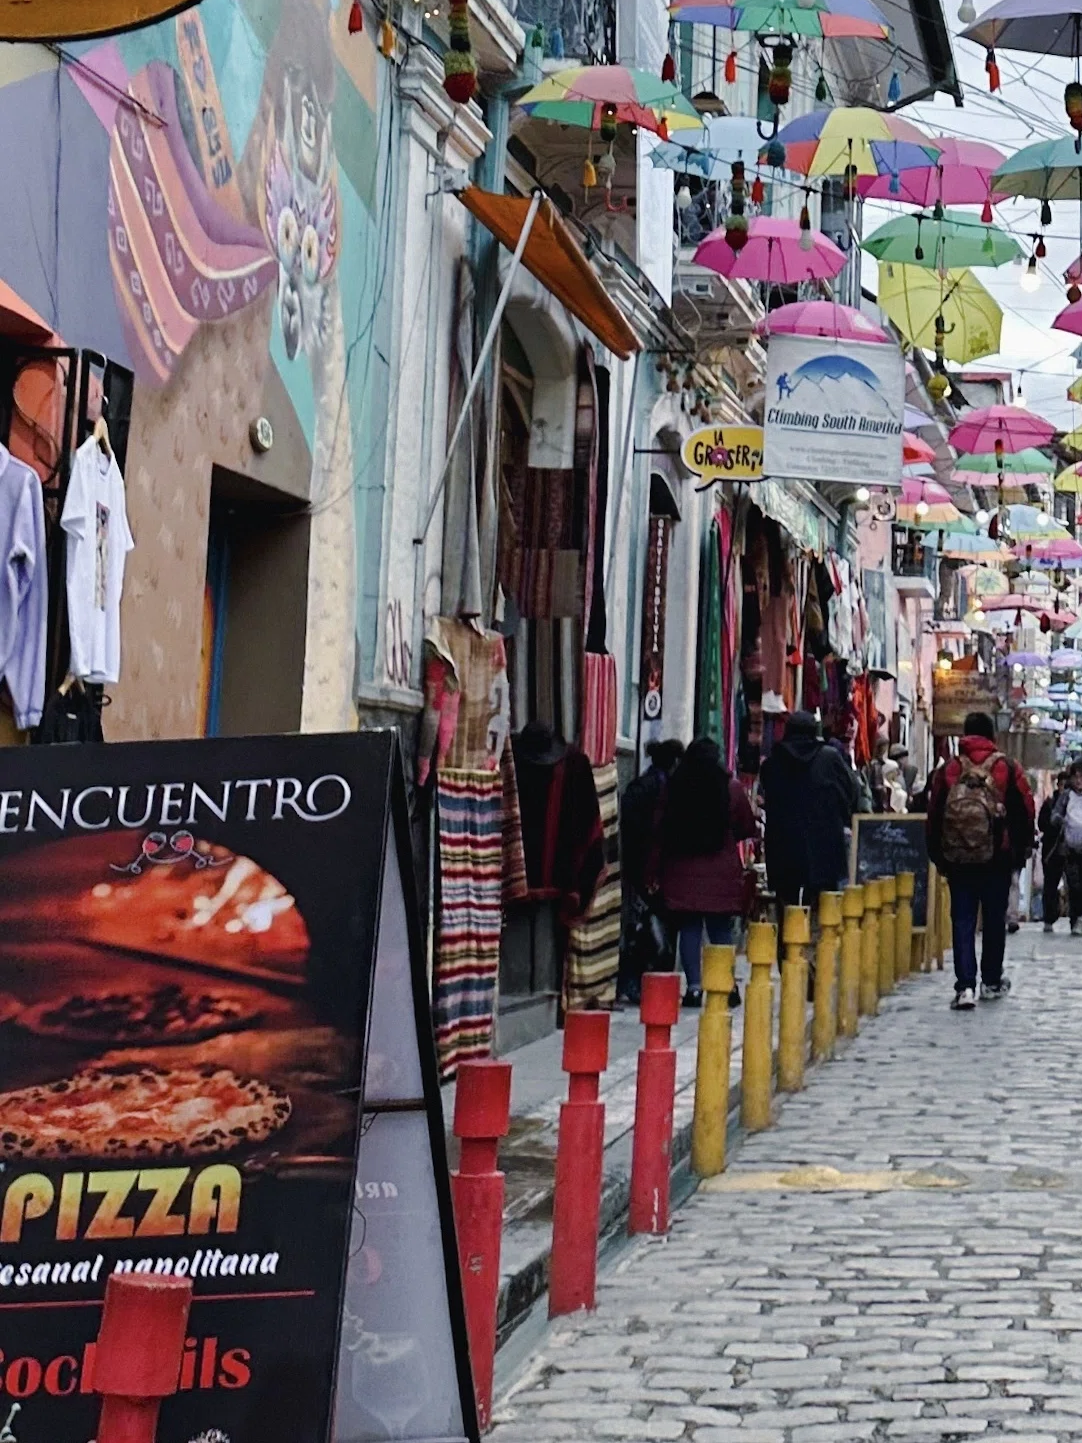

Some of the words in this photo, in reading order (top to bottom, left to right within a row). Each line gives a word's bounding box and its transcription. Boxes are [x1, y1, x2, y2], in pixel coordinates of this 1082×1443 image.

[714, 430, 724, 446] LA
[767, 407, 819, 430] Climbing
[821, 413, 857, 432] South
[652, 586, 661, 653] BOLIVIA
[0, 1164, 242, 1244] PIZZA
[0, 1253, 103, 1286] esanal
[0, 1336, 251, 1398] ocils
